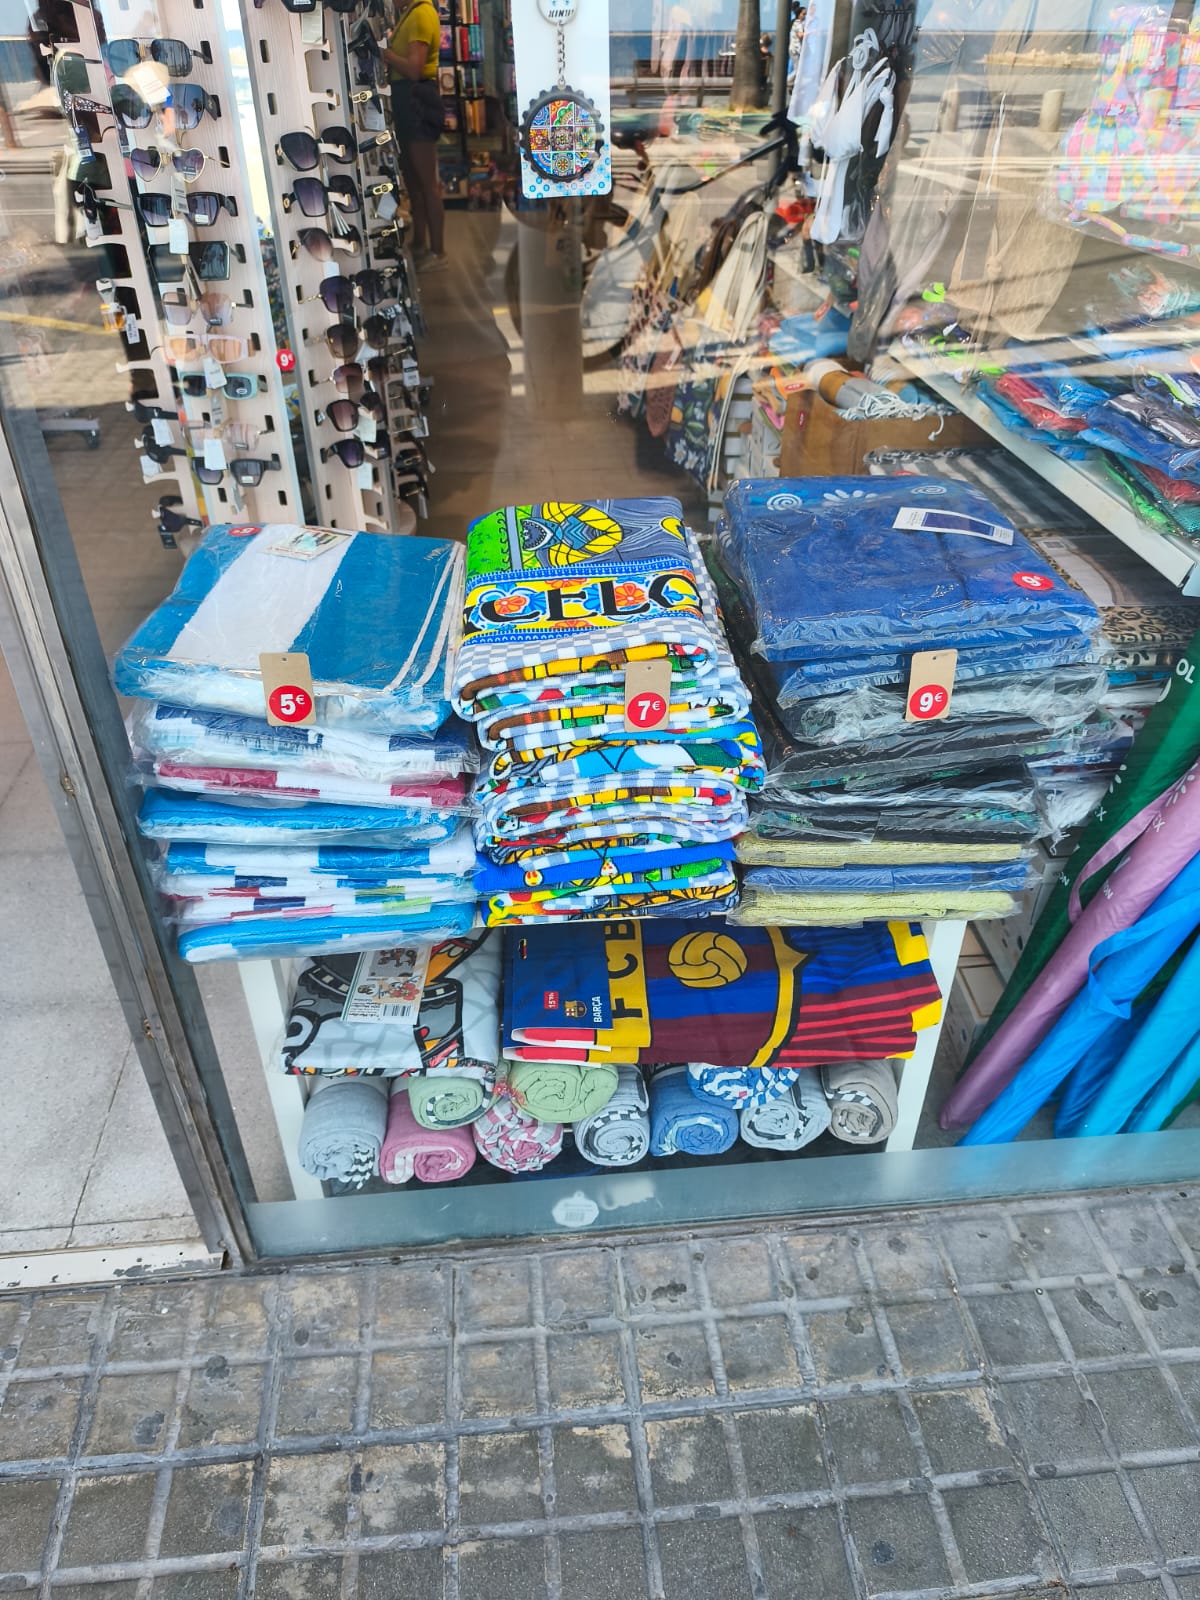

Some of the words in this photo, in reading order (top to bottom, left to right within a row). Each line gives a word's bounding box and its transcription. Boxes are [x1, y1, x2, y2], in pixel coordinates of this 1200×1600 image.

[280, 353, 294, 367] 9€
[1021, 574, 1045, 588] 9€
[280, 693, 306, 716] 5€
[637, 700, 661, 721] 7€
[919, 692, 944, 713] 9€
[591, 995, 603, 1023] BARÇA
